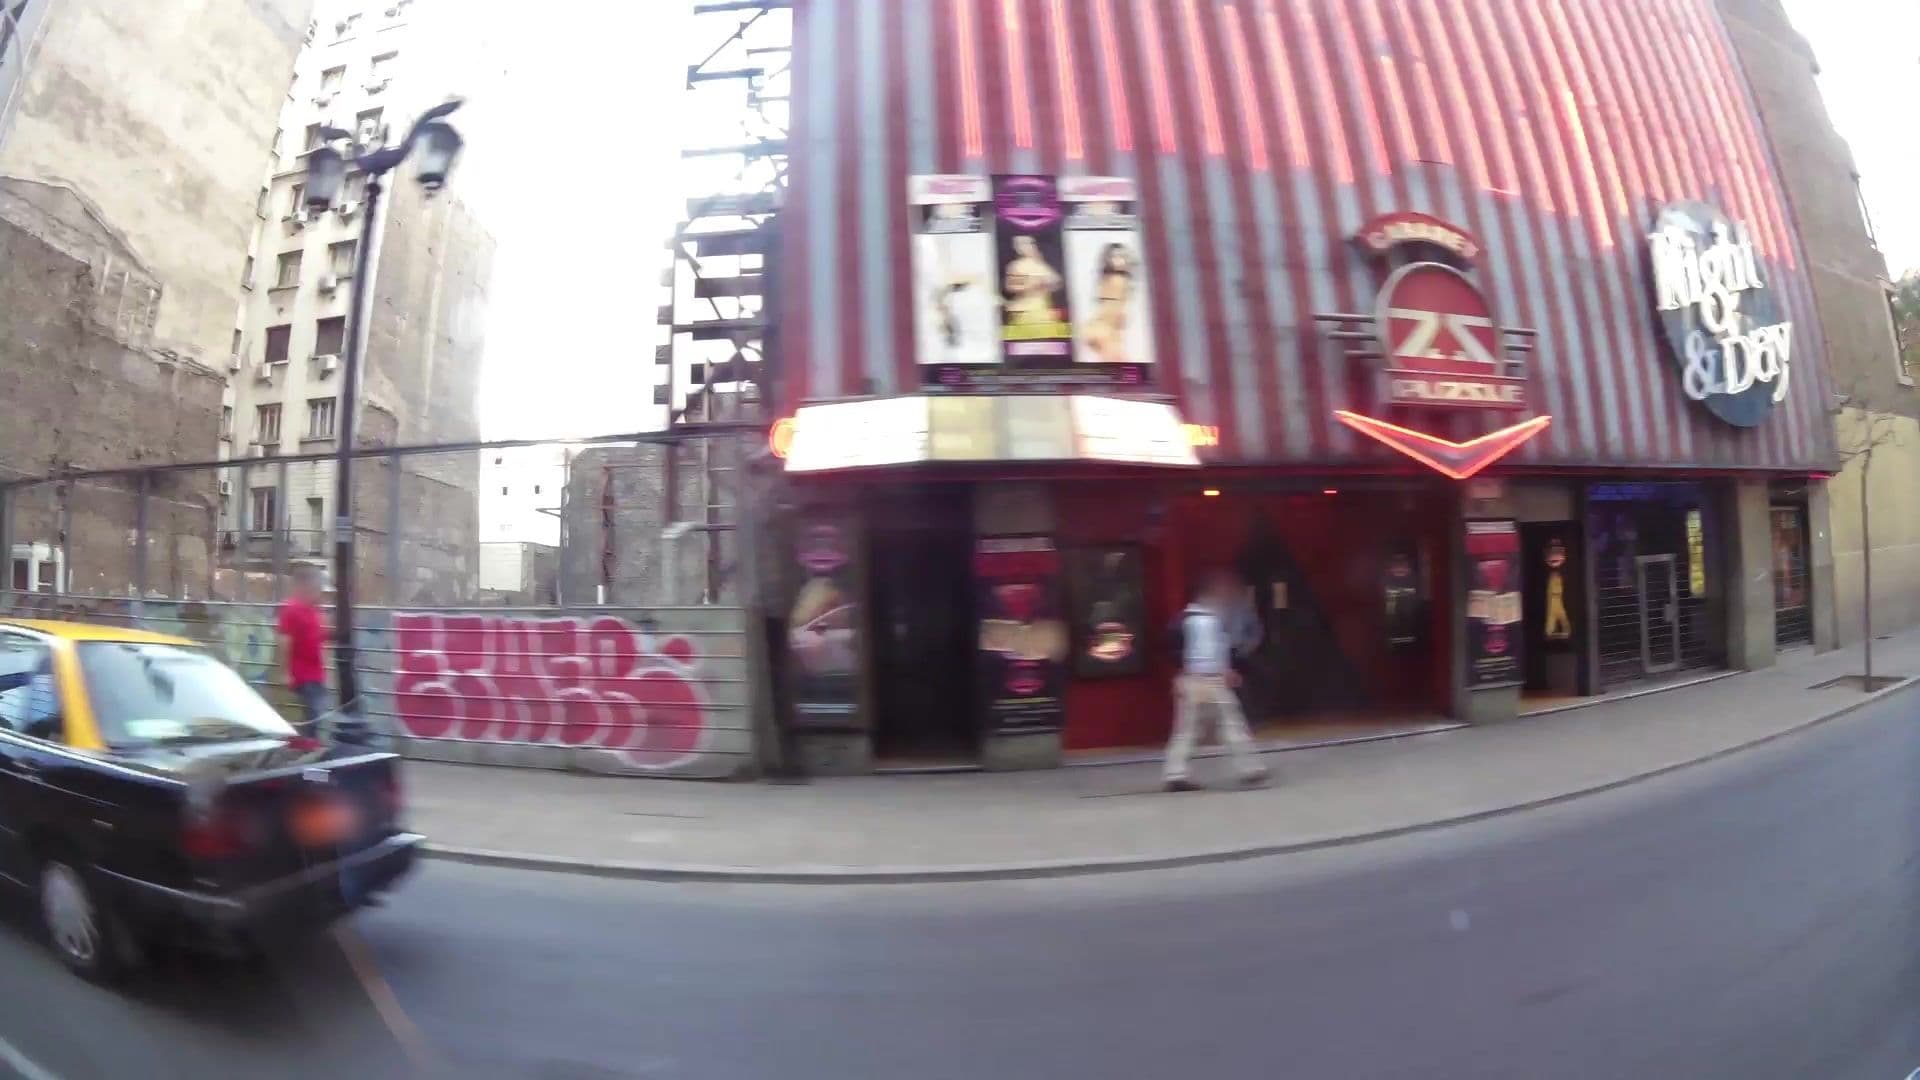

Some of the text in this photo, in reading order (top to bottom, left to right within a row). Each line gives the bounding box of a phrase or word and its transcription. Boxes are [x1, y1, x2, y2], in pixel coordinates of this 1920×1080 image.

[1648, 218, 1764, 338] Night
[1682, 321, 1793, 402] & Day
